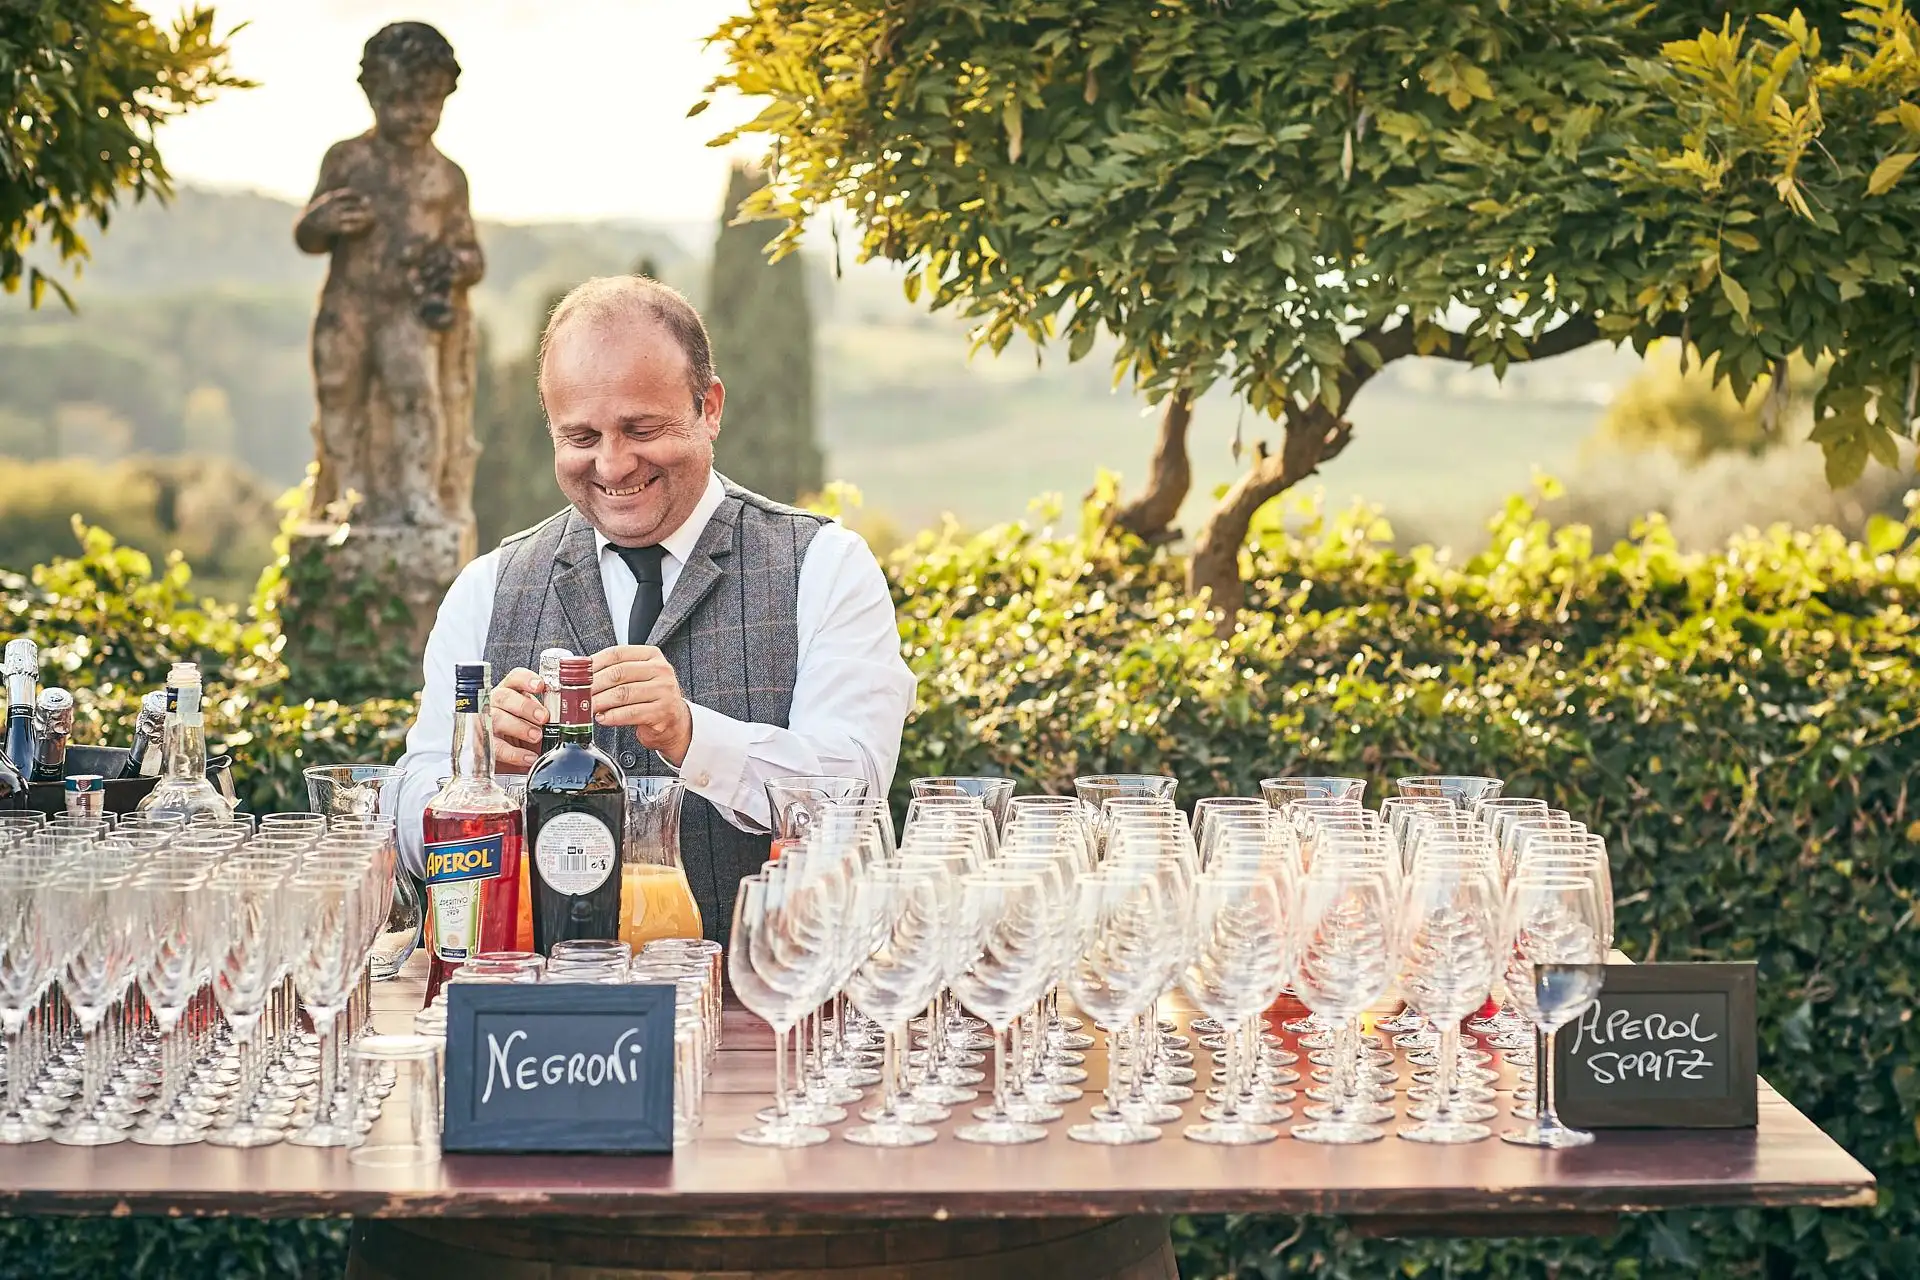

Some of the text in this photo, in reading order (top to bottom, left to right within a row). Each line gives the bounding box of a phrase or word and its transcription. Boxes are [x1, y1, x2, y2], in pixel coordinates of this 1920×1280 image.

[426, 848, 492, 878] APEROL
[1570, 998, 1718, 1055] APEROL
[1586, 1048, 1714, 1084] SPRITZ
